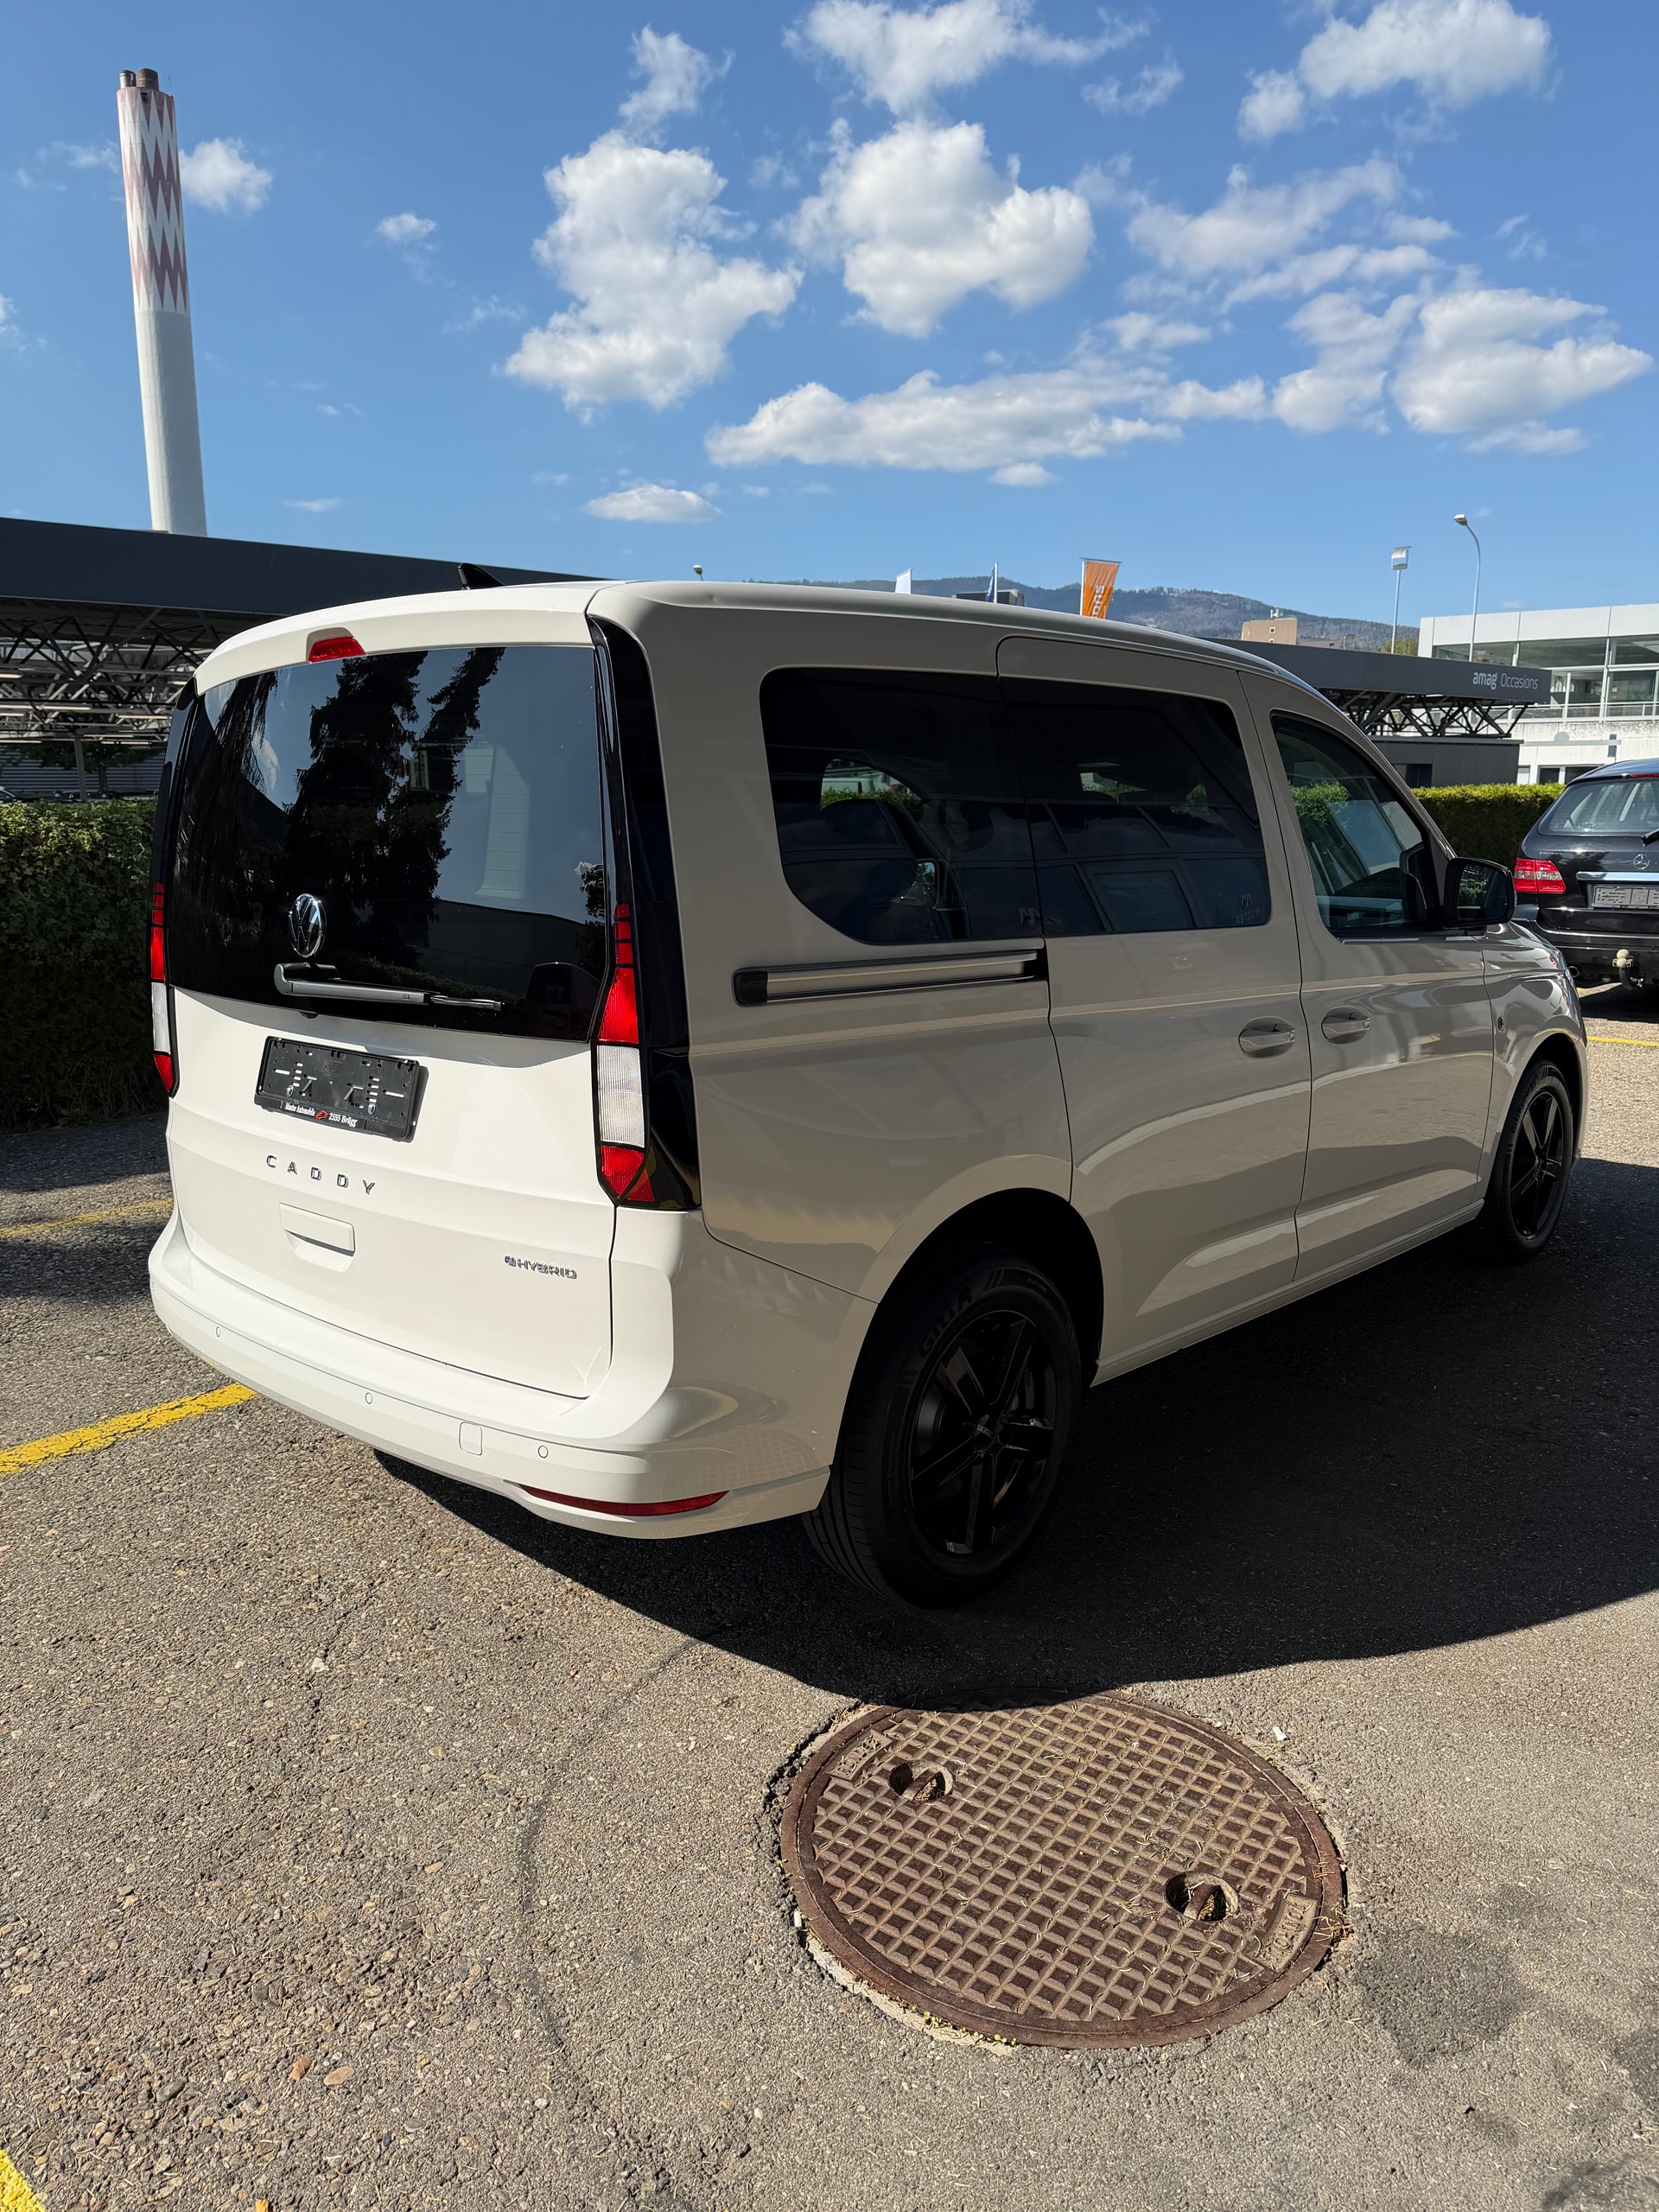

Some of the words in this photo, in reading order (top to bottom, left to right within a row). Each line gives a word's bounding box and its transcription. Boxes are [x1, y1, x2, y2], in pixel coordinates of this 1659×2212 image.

[1472, 671, 1497, 690] amag
[1501, 672, 1538, 690] Occasions
[328, 1112, 341, 1122] 2555
[341, 1115, 358, 1128] Brügg
[266, 1155, 375, 1195] CADDY
[1027, 1277, 1047, 1293] OUTSIDE
